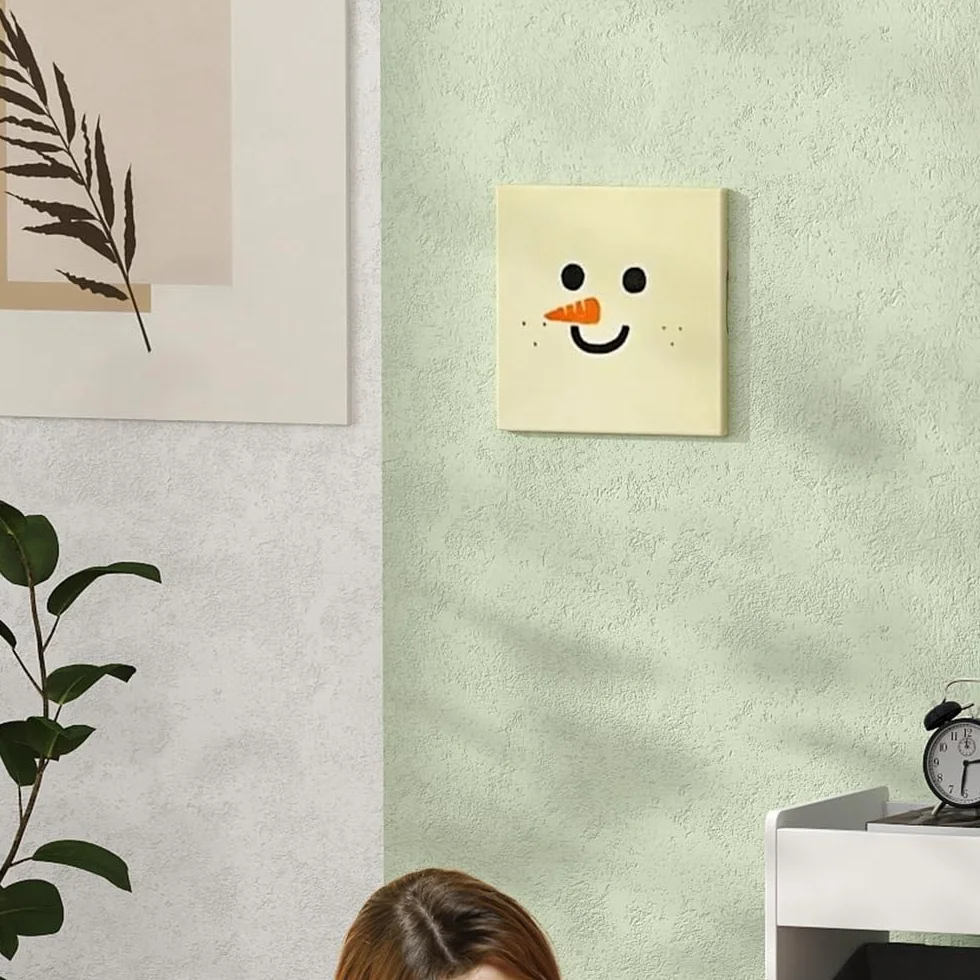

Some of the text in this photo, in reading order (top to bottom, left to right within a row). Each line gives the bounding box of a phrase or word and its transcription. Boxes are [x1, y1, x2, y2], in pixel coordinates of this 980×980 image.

[950, 731, 958, 741] 11
[963, 728, 973, 738] 12
[939, 742, 948, 752] 10
[933, 757, 940, 767] 9
[937, 773, 943, 782] 8
[948, 785, 954, 794] 7
